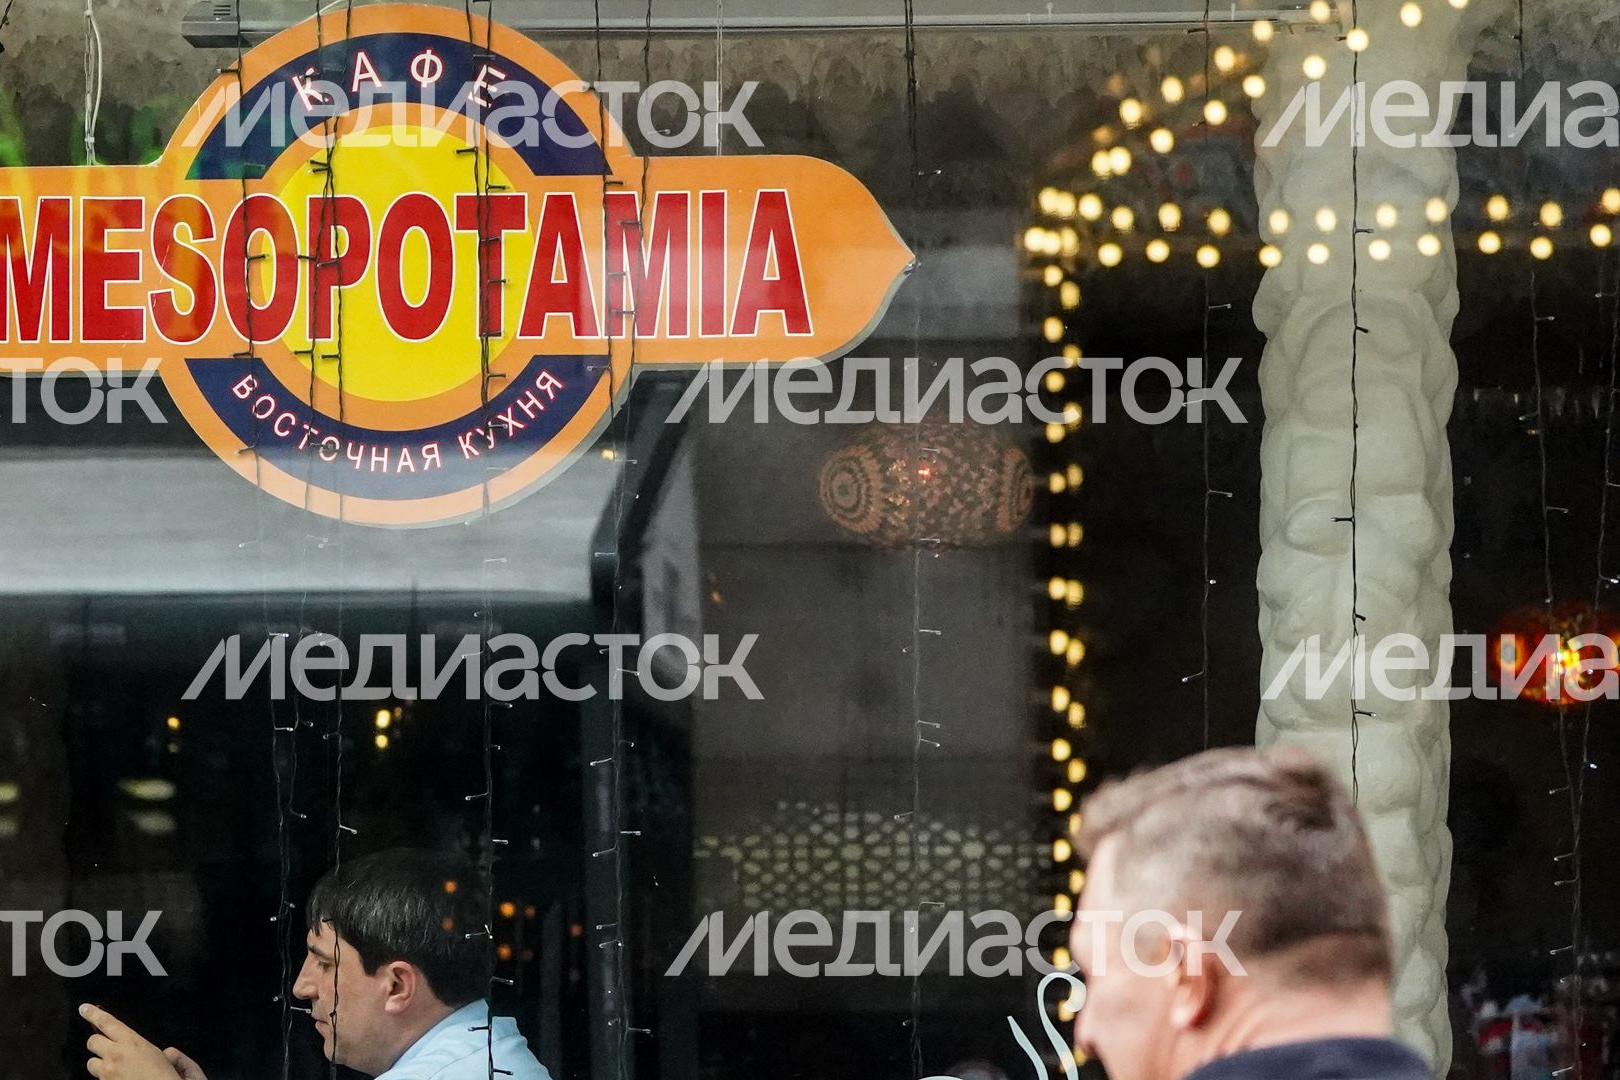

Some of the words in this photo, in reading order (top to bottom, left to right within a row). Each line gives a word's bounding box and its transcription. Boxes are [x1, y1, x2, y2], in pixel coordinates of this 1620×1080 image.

[292, 50, 507, 112] КАФЕ
[232, 374, 442, 473] ВОСТОЧНАЯ
[458, 369, 564, 459] КУХНЯ
